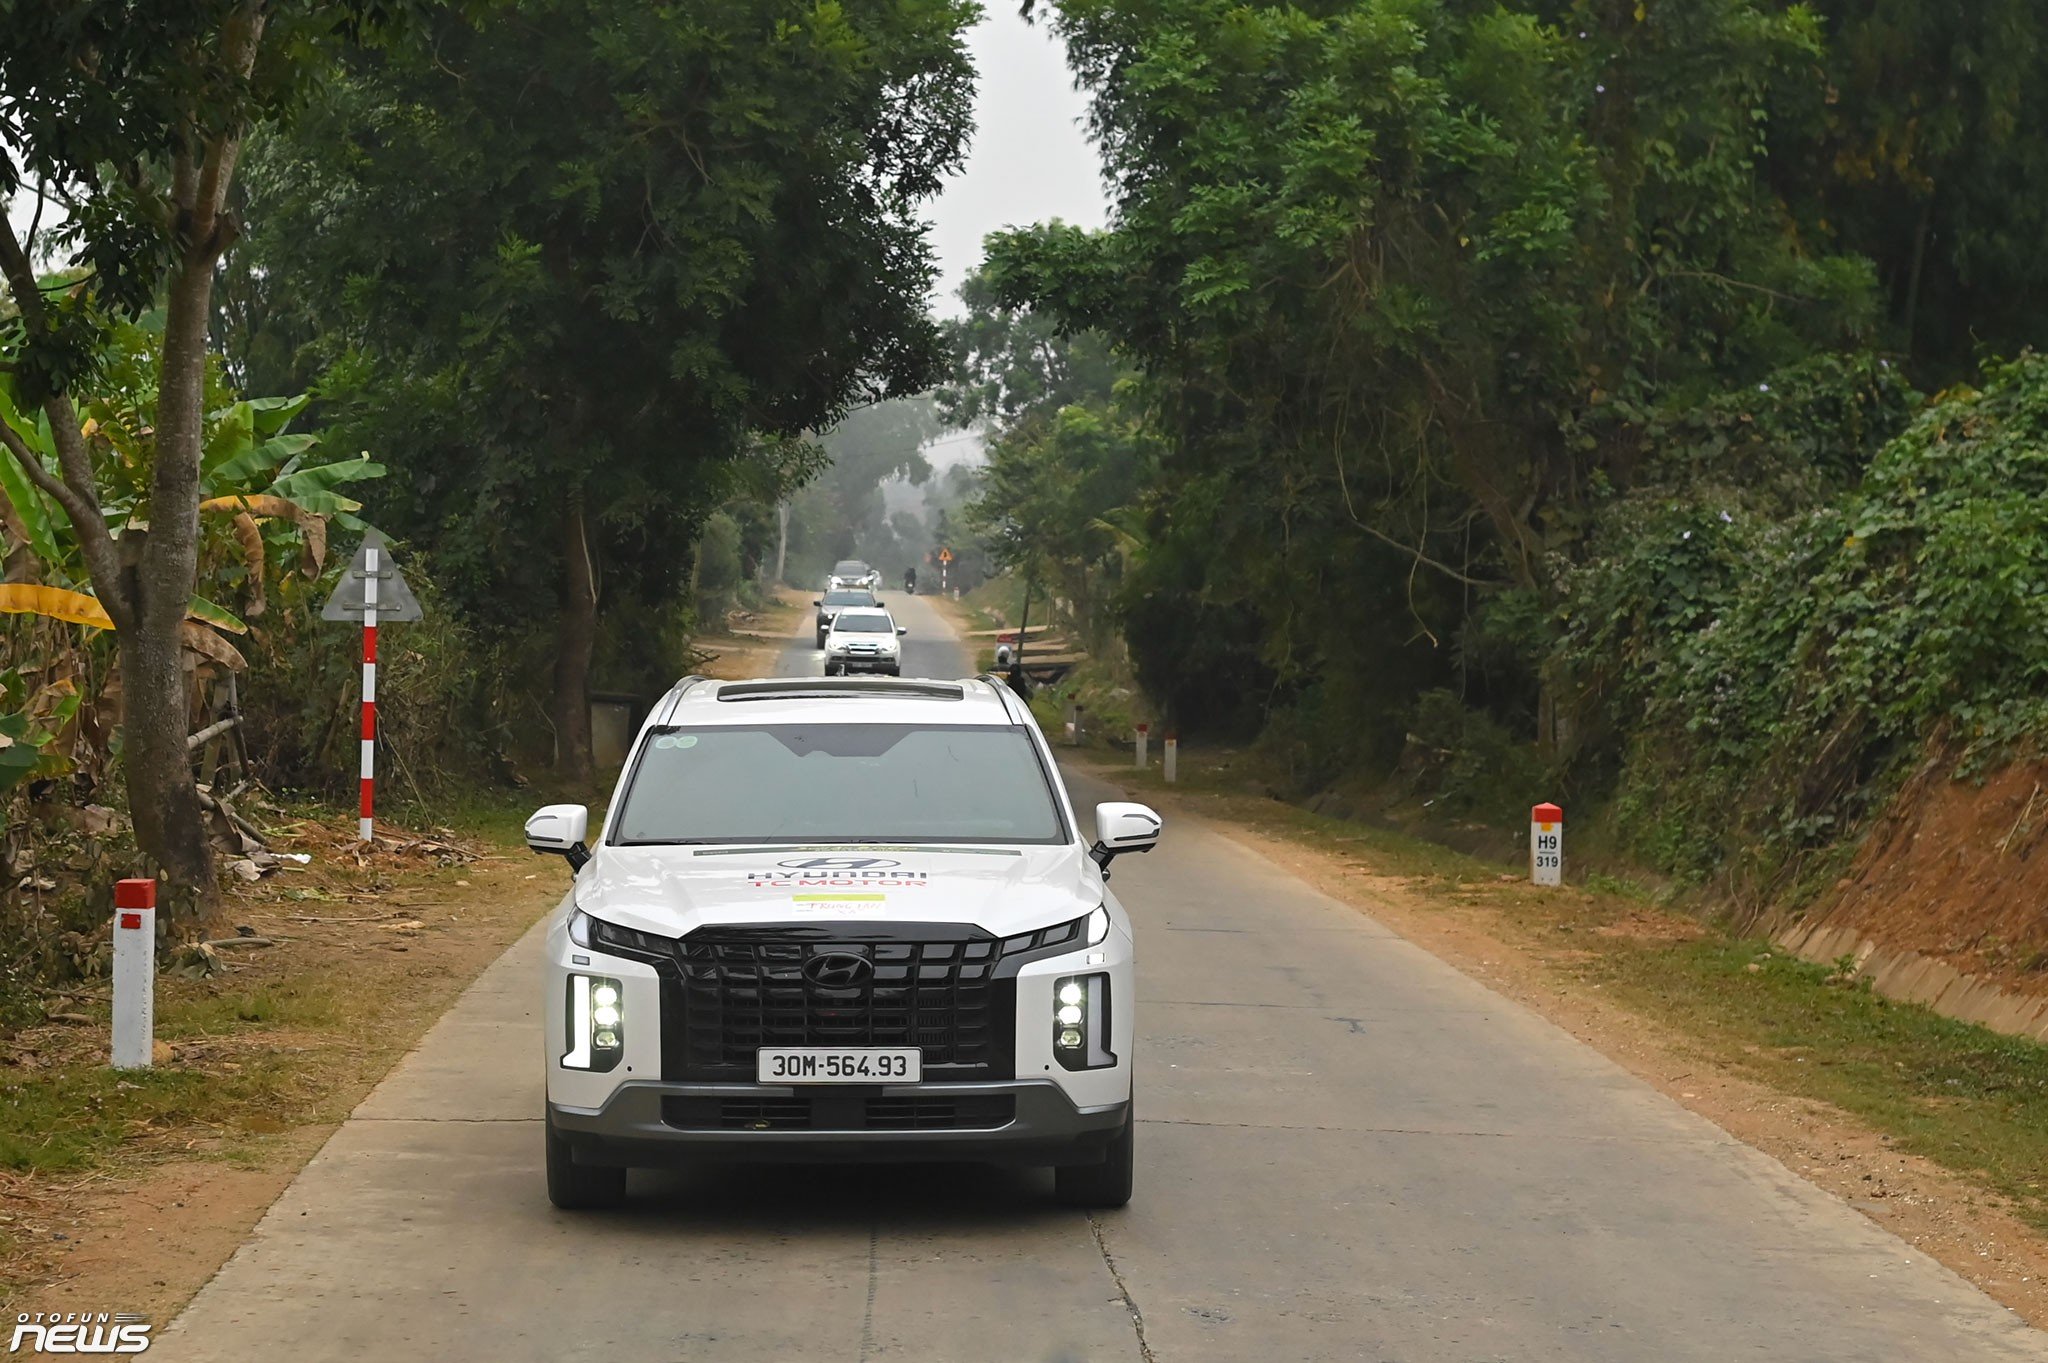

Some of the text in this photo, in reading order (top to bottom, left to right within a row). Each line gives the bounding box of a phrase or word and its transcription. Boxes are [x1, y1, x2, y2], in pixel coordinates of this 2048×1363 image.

[1538, 835, 1557, 849] H9
[1536, 856, 1558, 867] 319
[748, 871, 927, 879] HYUNDAI
[772, 1055, 907, 1077] 30M-564.93
